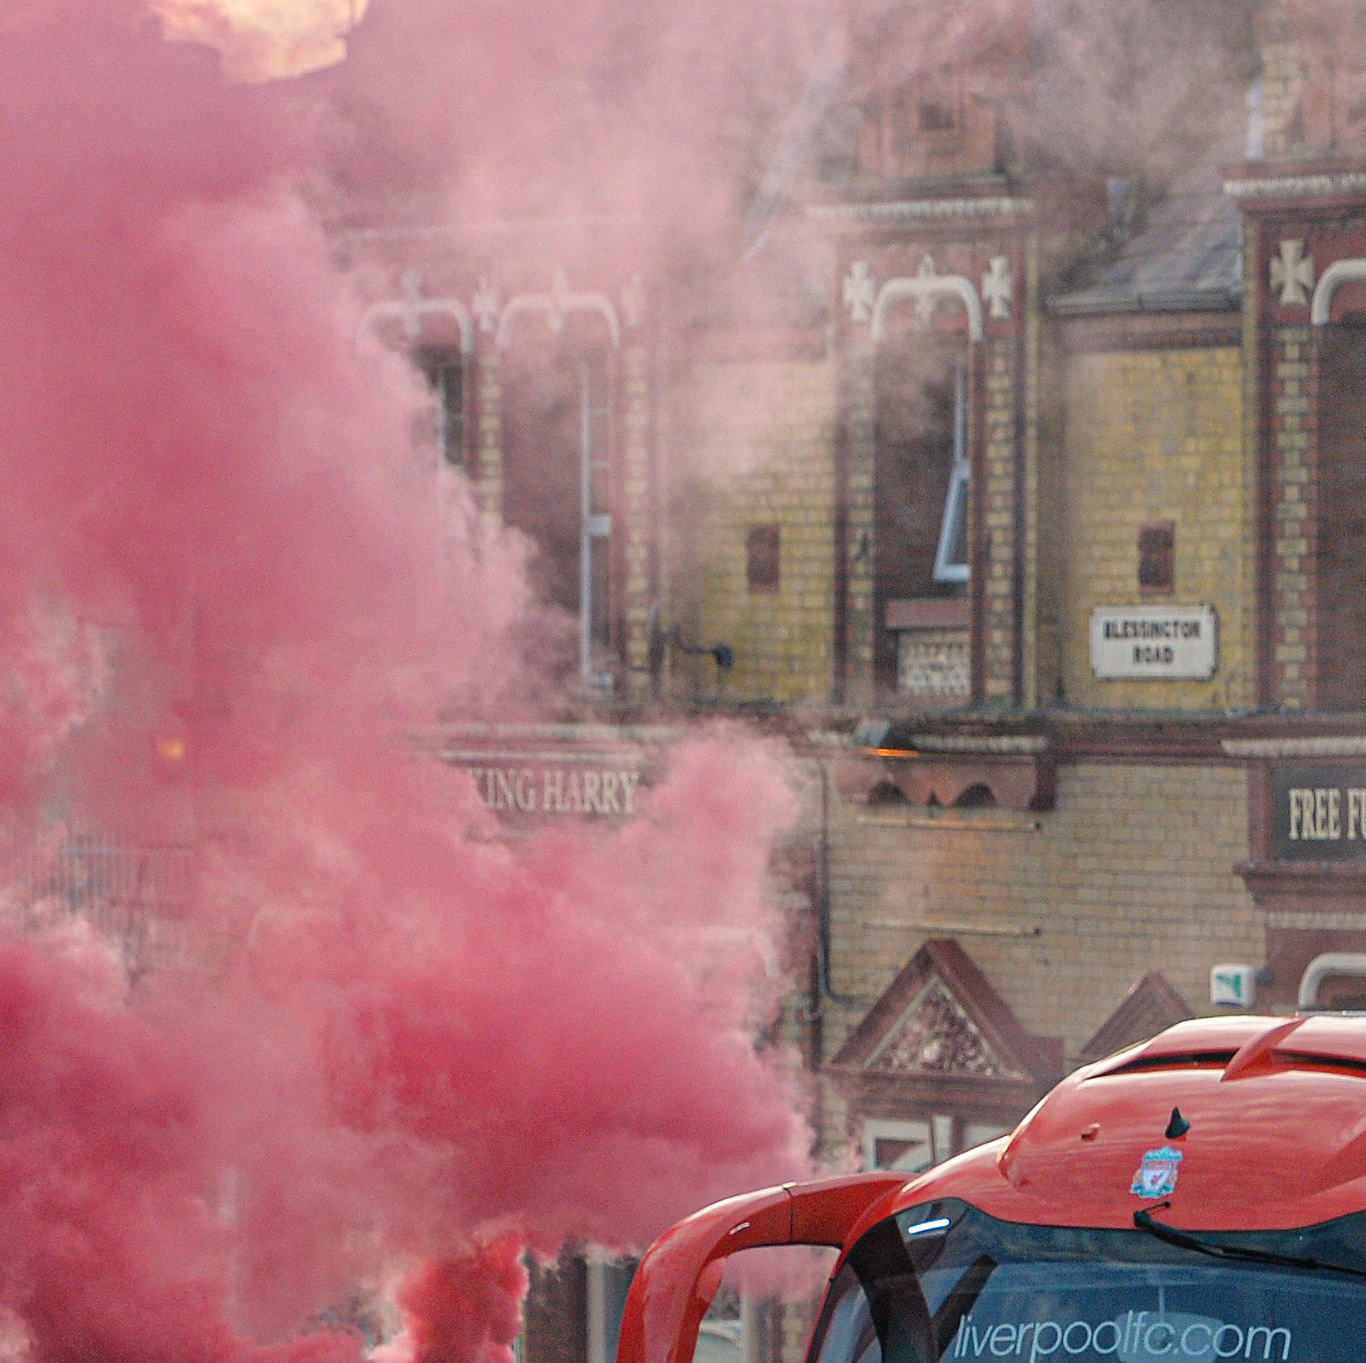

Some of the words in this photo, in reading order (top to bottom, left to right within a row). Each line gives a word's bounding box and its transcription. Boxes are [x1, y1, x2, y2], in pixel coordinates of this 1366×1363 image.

[1133, 646, 1174, 664] ROAD
[542, 769, 640, 815] HARRY
[1288, 787, 1341, 841] FREE
